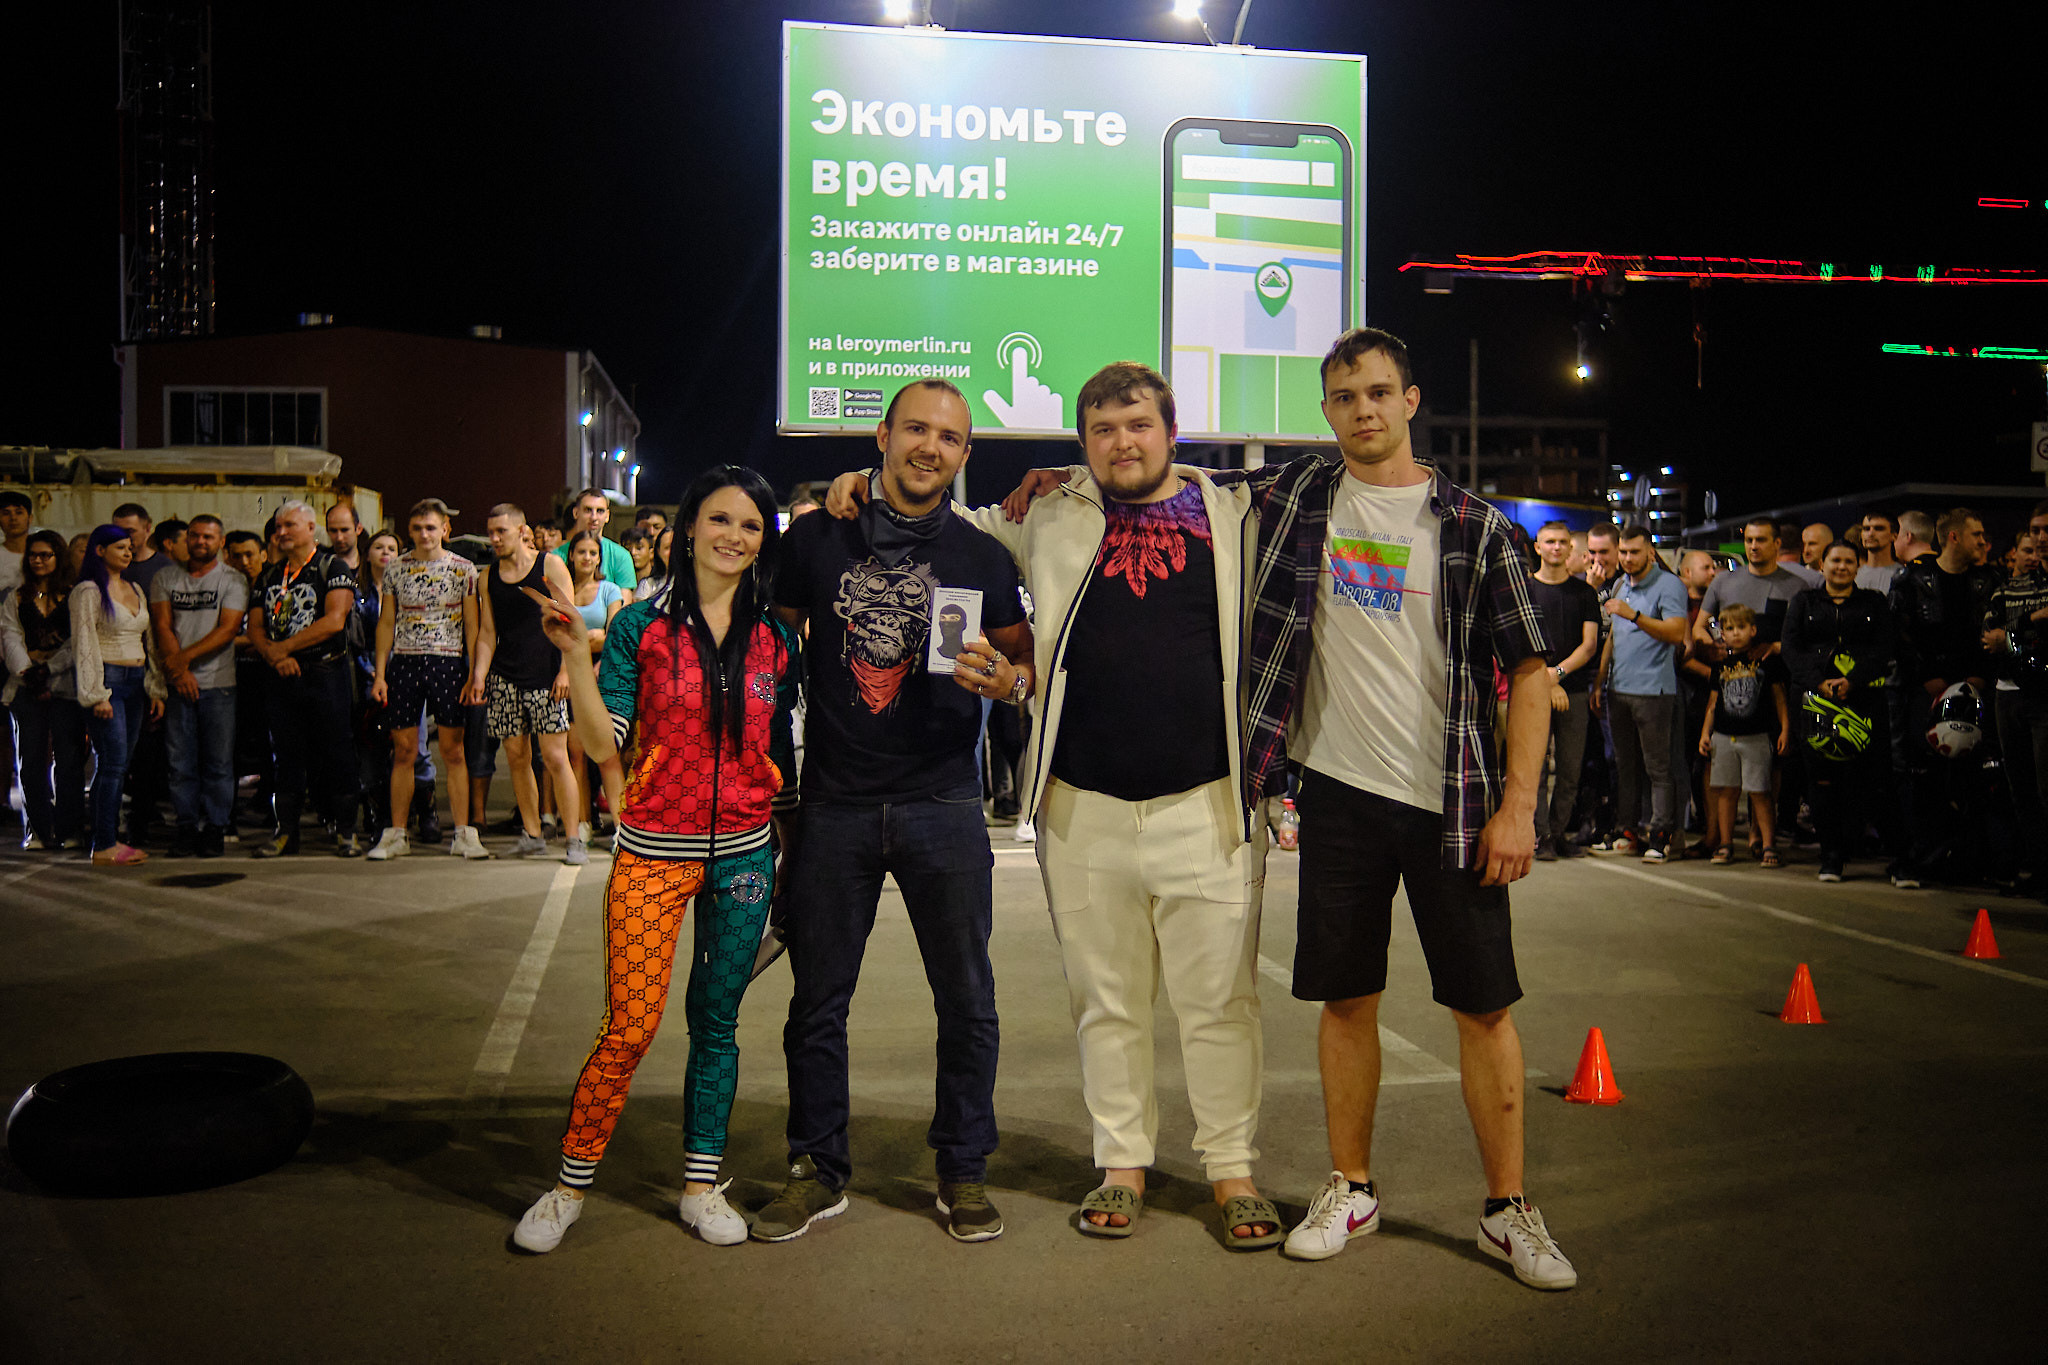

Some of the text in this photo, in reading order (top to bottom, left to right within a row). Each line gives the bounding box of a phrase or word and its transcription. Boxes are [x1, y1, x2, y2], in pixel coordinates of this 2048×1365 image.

[811, 89, 1127, 147] Экономьте
[811, 157, 1007, 207] время!
[810, 214, 1124, 249] Закажите онлайн 24/7
[810, 245, 1100, 278] заберите в магазине
[809, 334, 972, 357] на leroymerlin.ru
[809, 361, 972, 381] и в приложении
[1371, 531, 1392, 542] MILAN
[1396, 535, 1415, 545] ITALY
[1381, 591, 1399, 611] 08
